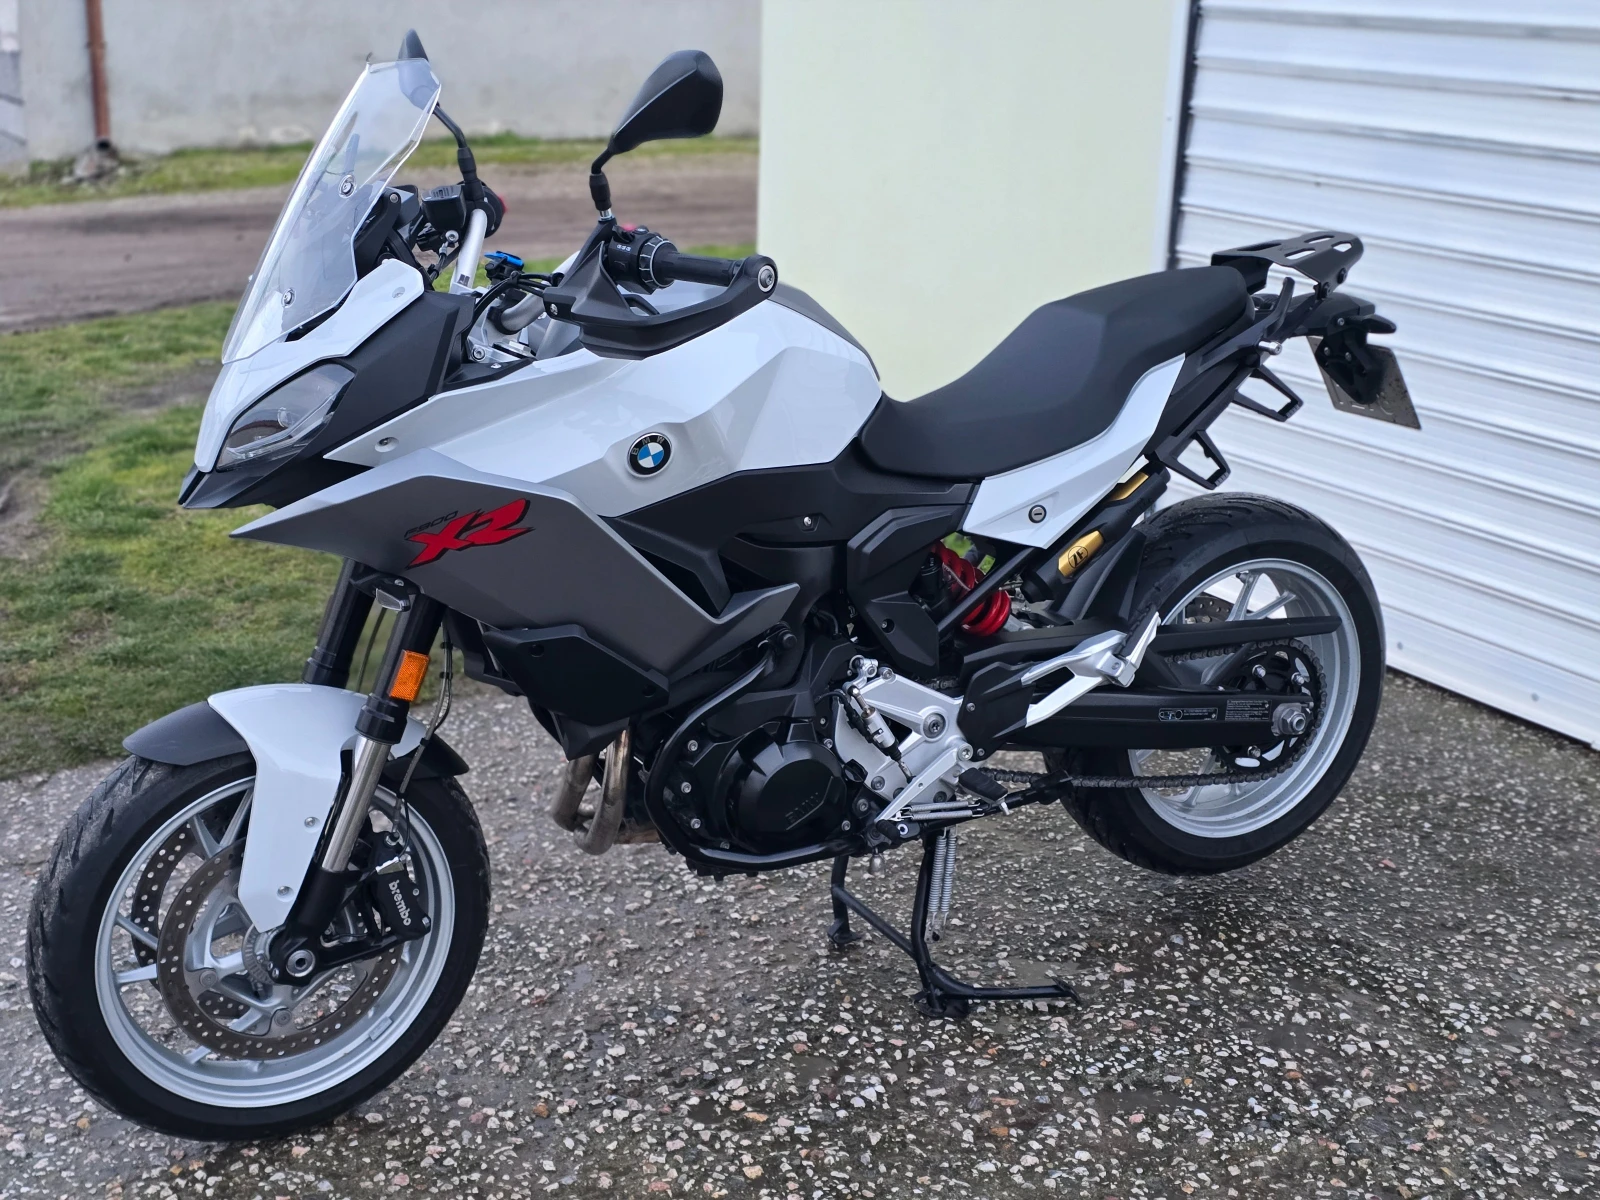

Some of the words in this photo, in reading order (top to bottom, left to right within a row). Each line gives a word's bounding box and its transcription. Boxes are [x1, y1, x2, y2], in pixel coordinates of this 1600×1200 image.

[631, 435, 665, 456] BMW
[403, 498, 536, 571] XR
[388, 879, 412, 926] brembo
